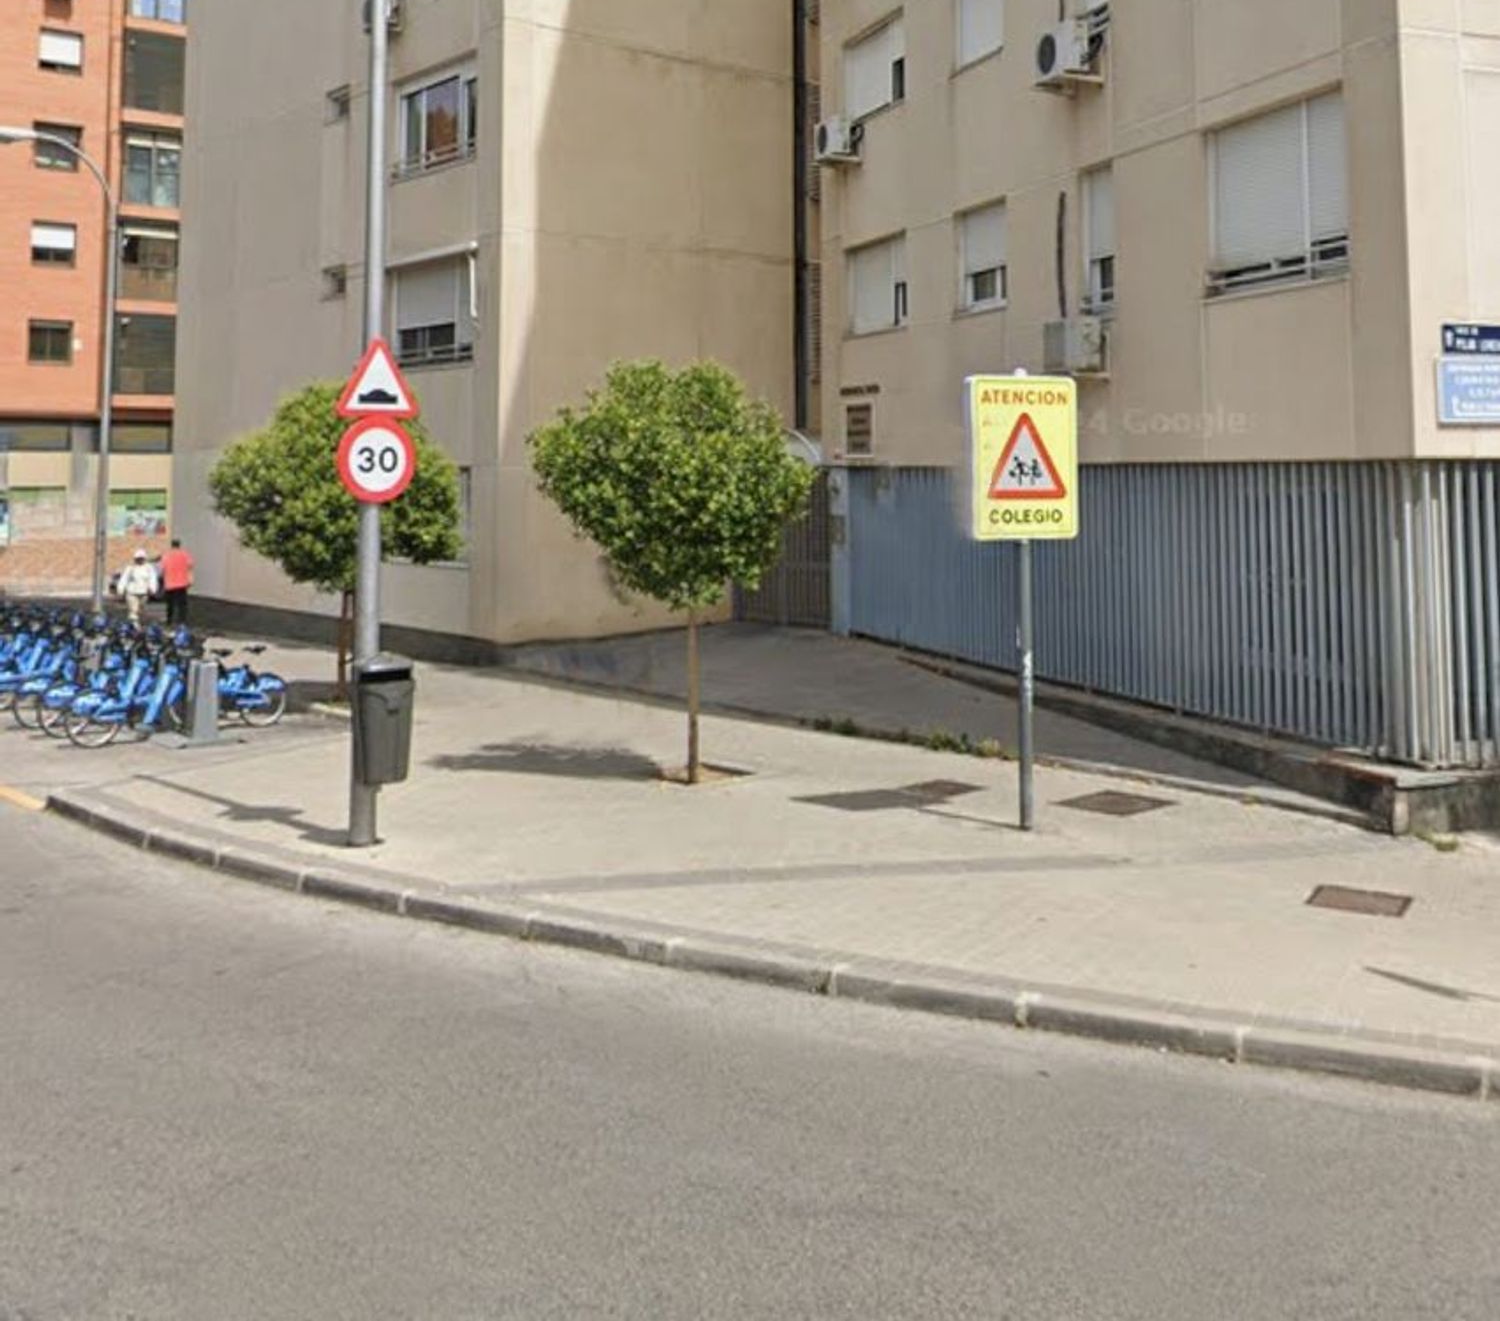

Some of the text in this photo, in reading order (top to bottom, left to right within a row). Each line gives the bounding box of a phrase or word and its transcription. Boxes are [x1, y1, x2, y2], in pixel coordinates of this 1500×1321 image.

[980, 389, 1068, 405] ATENCION
[358, 447, 398, 473] 30
[988, 508, 1063, 525] COLEGIO
